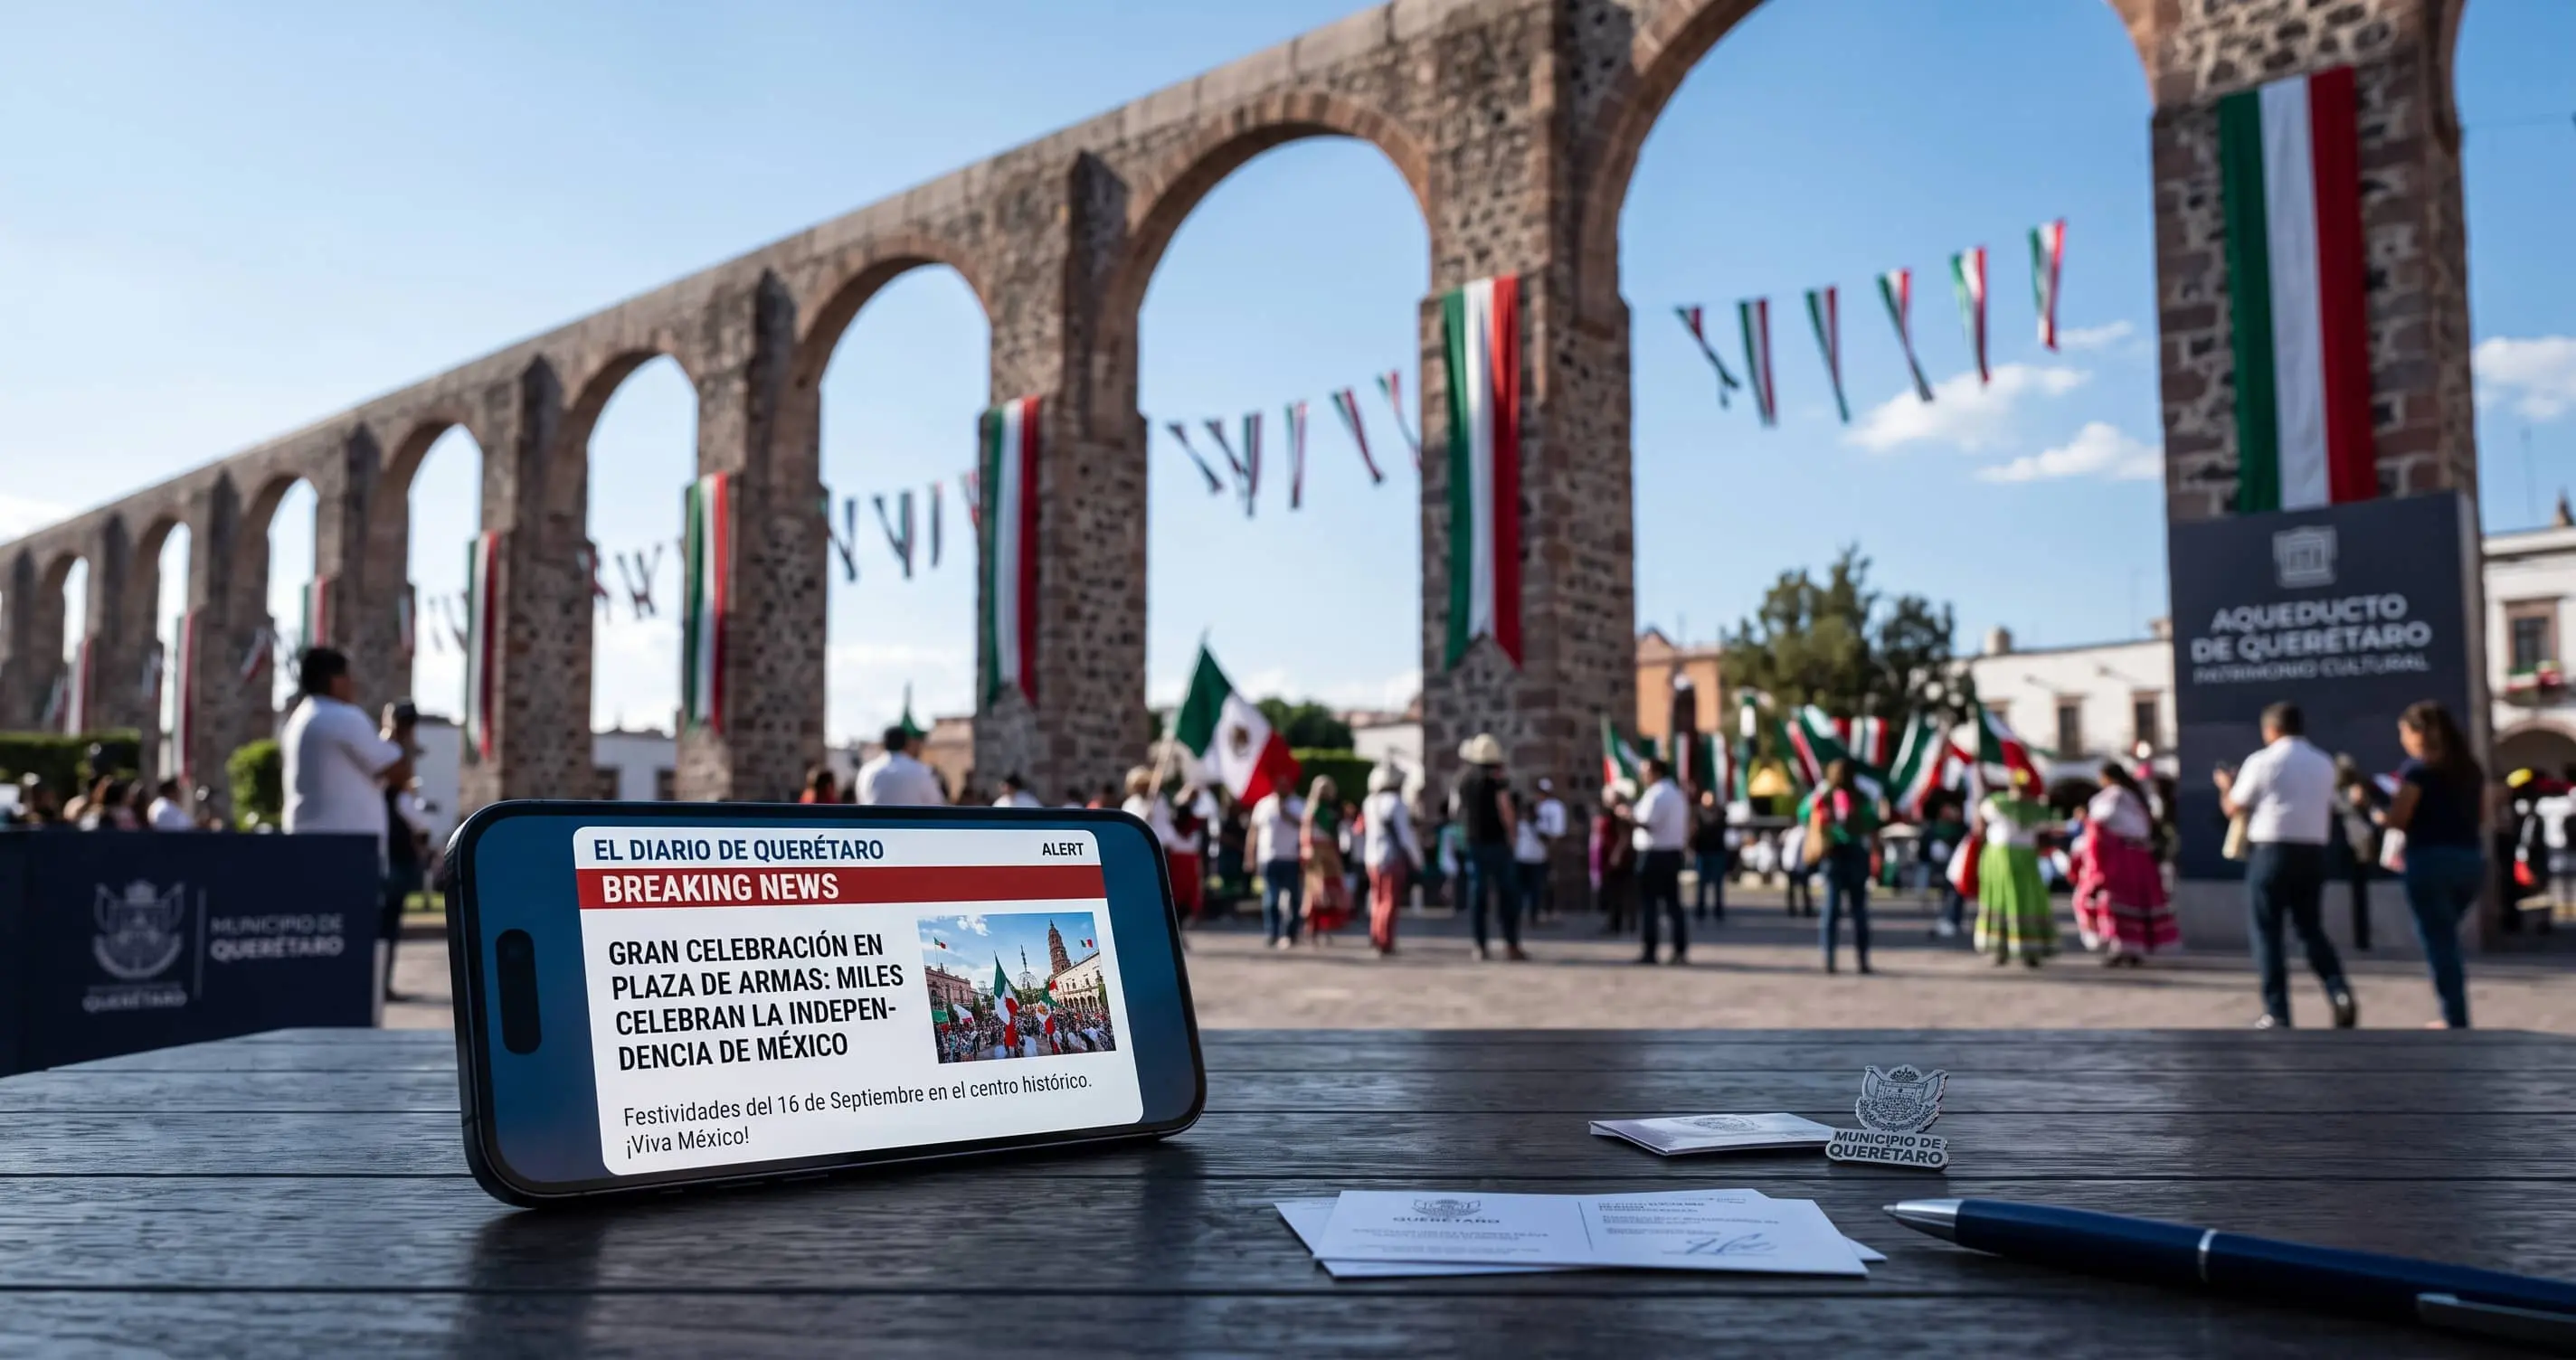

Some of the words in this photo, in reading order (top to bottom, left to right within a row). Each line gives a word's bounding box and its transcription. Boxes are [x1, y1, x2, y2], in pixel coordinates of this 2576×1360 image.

[2211, 593, 2408, 632] AQUEDUCTO
[2191, 638, 2234, 663] DE
[594, 839, 623, 861] EL
[630, 839, 711, 861] DIARIO
[718, 839, 748, 860] DE
[754, 834, 884, 863] QUERÉTARO
[1043, 842, 1084, 856] ALERT
[601, 874, 752, 903] BREAKING
[760, 873, 839, 900] NEWS
[317, 913, 344, 933] DE
[610, 940, 679, 966] GRAN
[686, 929, 848, 963] CELEBRACIÓN
[853, 933, 883, 957] EN
[612, 973, 695, 1001] PLAZA
[701, 971, 732, 996] DE
[738, 968, 830, 995] ARMAS:
[837, 964, 904, 990] MILES
[616, 1006, 745, 1036] CELEBRAN
[752, 1003, 784, 1027] LA
[790, 996, 896, 1025] INDEPEN-
[619, 1040, 713, 1072] DENCIA
[719, 1038, 751, 1064] DE
[757, 1029, 848, 1062] MÉXICO
[624, 1103, 741, 1127] Festividades
[746, 1095, 772, 1117] del
[778, 1094, 800, 1114] 16
[805, 1091, 826, 1112] de
[830, 1083, 924, 1113] Septiembre
[929, 1087, 948, 1101] en
[952, 1081, 966, 1100] el
[971, 1079, 1018, 1098] centro
[1023, 1072, 1093, 1093] histórico.
[626, 1136, 672, 1160] ¡Viva
[678, 1125, 750, 1150] México!
[1834, 1130, 1916, 1147] MUNICIPIO
[1919, 1138, 1942, 1149] DE
